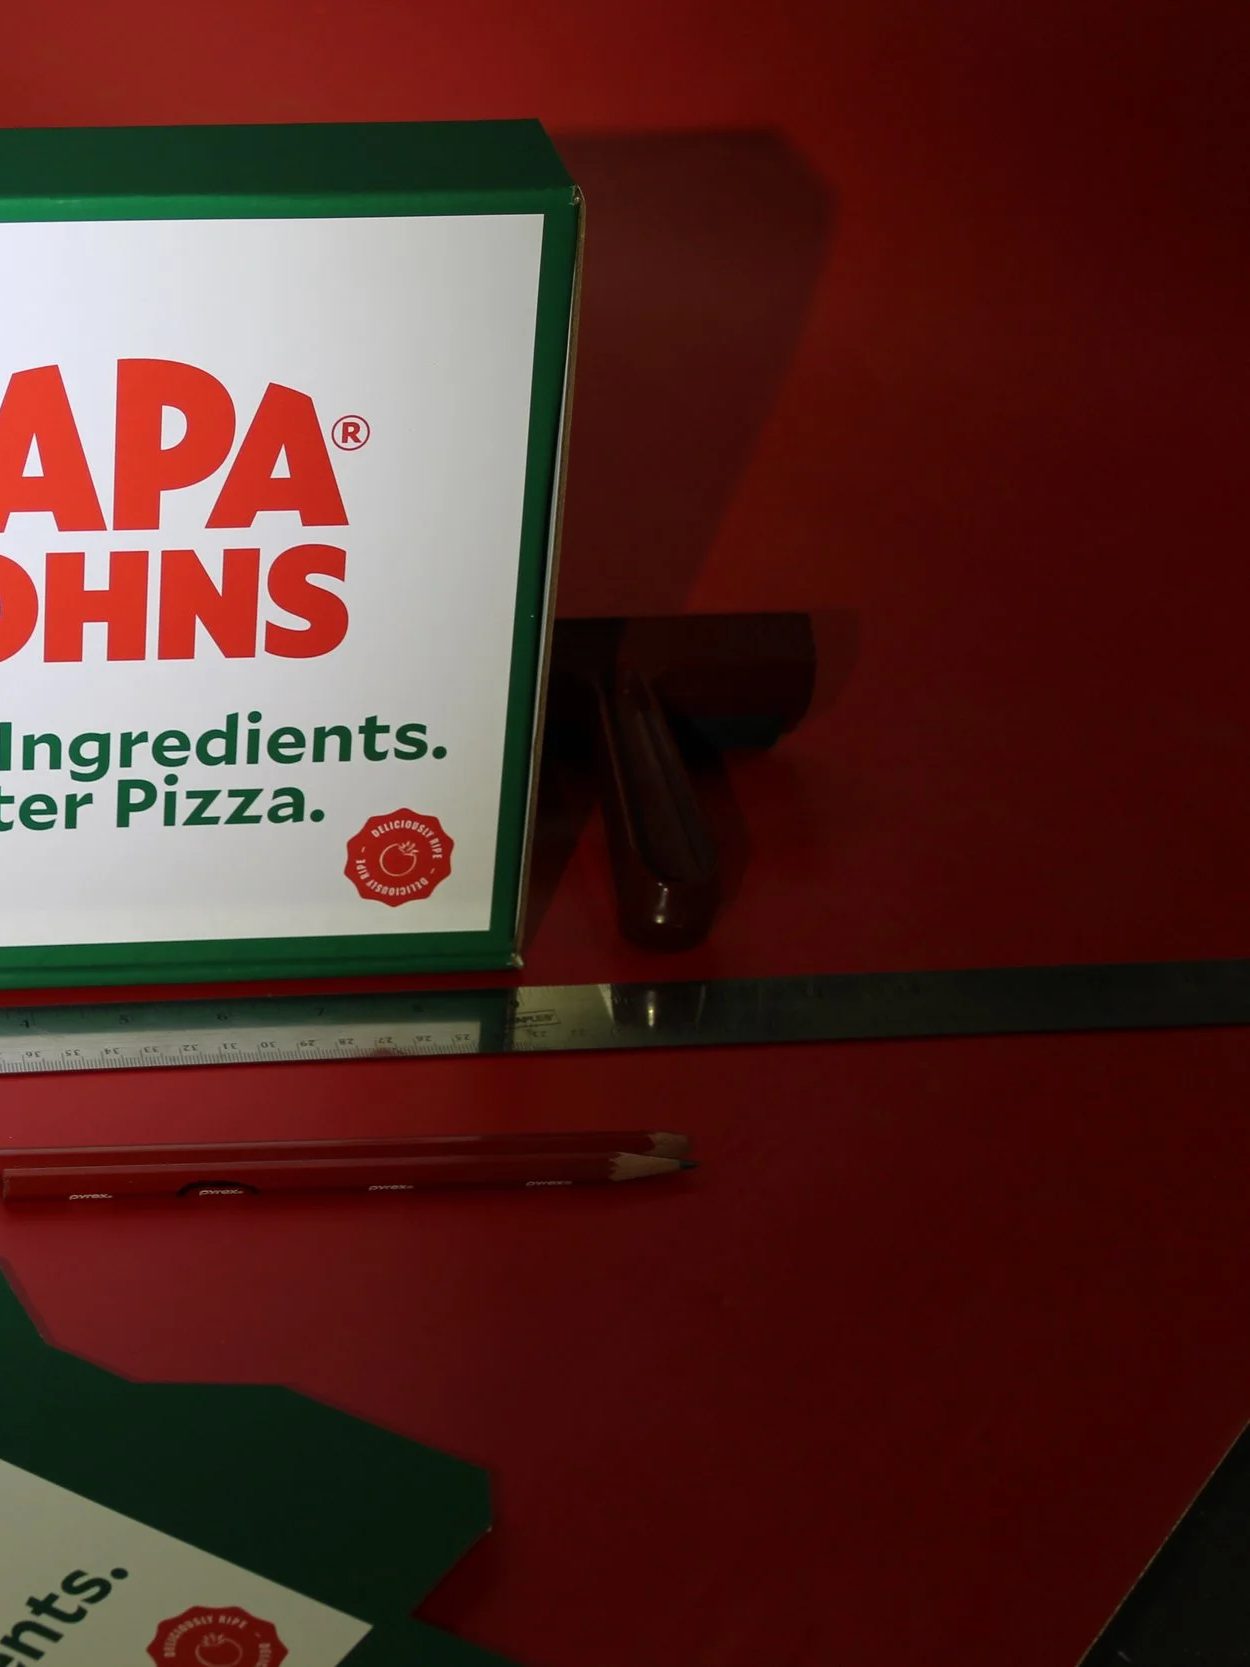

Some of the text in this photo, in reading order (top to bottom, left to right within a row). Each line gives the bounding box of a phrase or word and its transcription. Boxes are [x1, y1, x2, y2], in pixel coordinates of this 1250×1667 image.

[114, 774, 326, 829] Pizza.
[371, 820, 443, 859] DELICIOUSLY RIPE
[356, 859, 429, 896] DELICIOUSLY RIPE
[217, 1614, 249, 1630] RIPE
